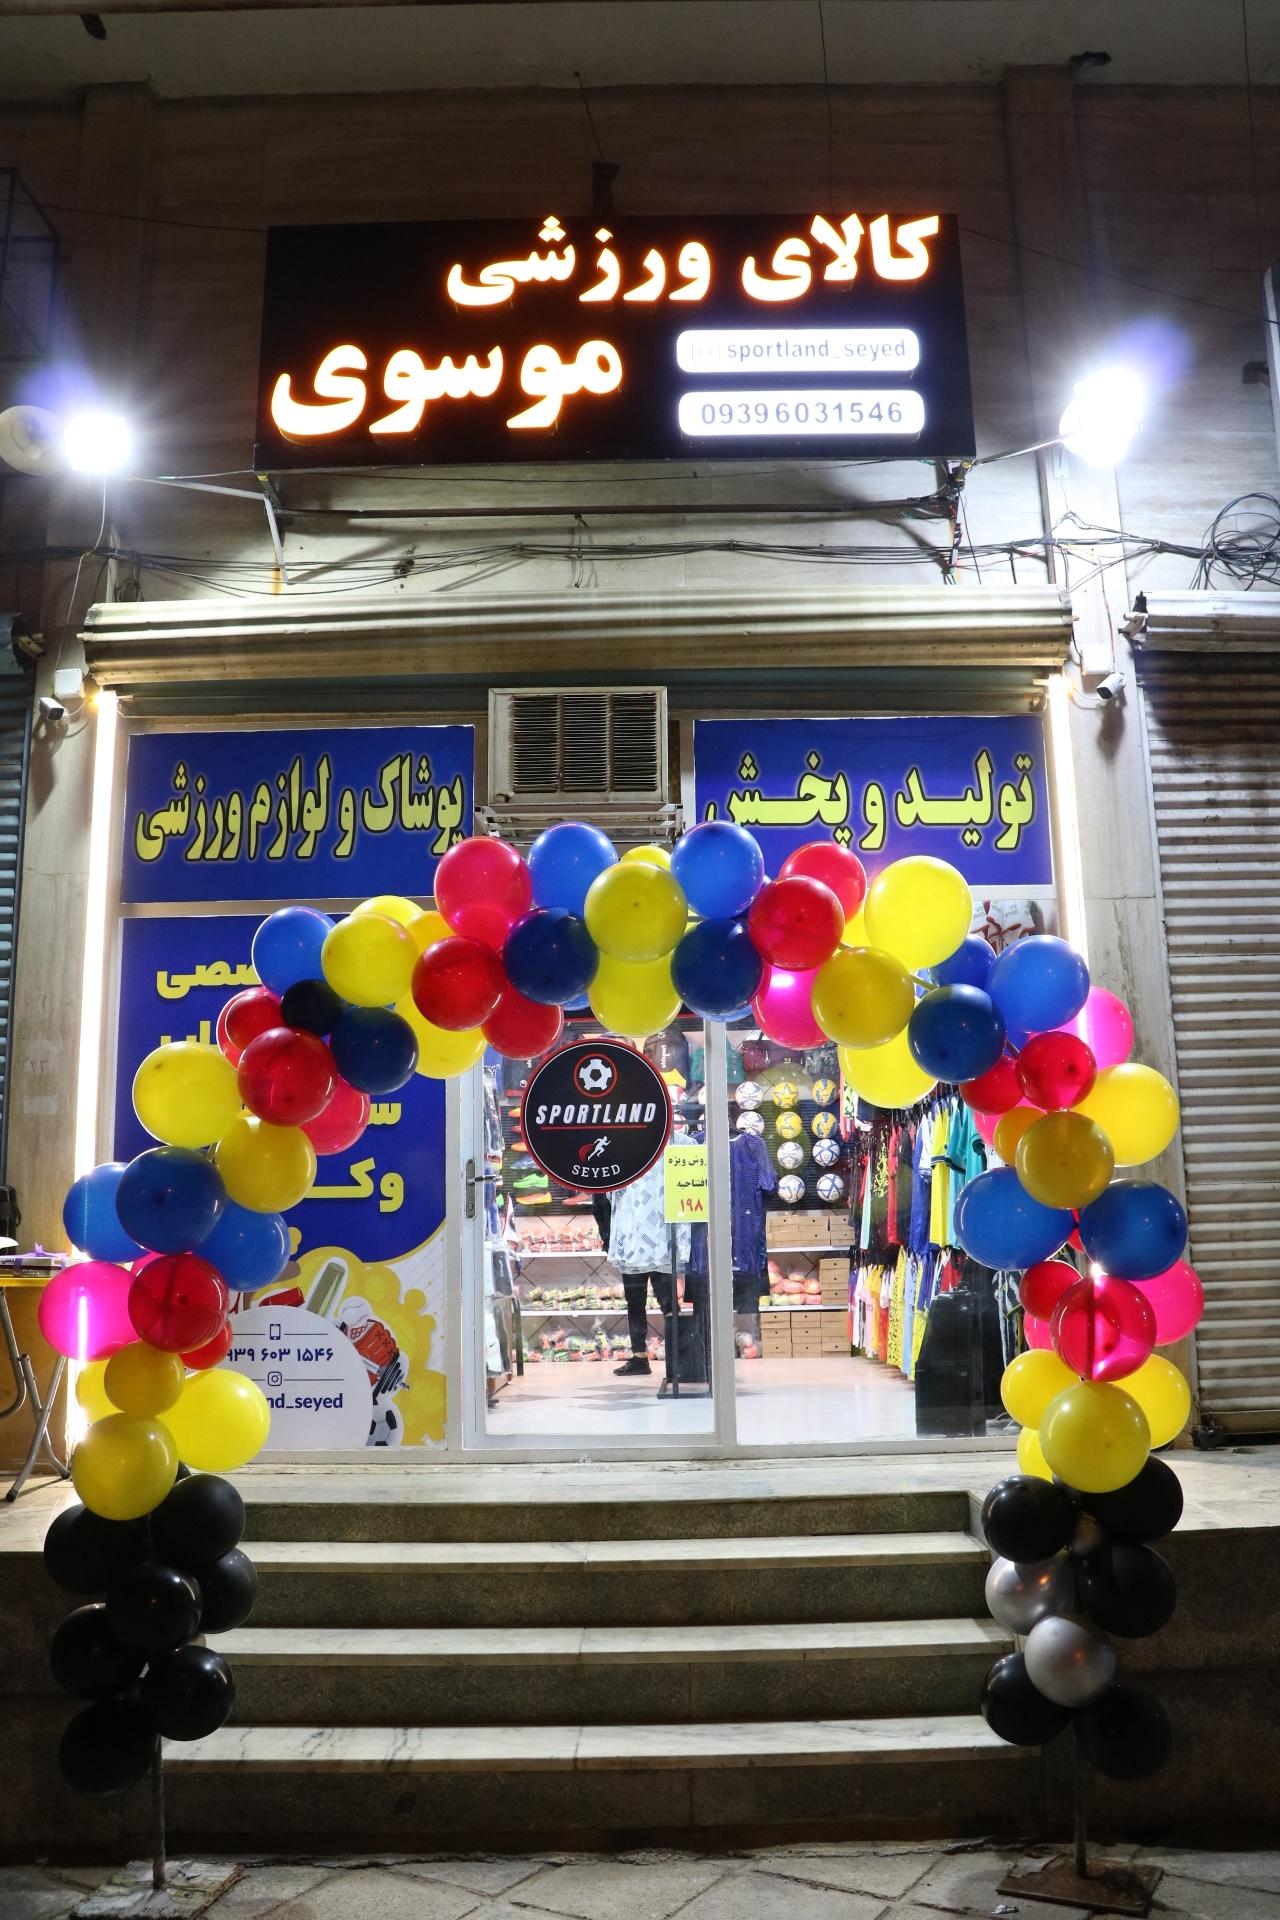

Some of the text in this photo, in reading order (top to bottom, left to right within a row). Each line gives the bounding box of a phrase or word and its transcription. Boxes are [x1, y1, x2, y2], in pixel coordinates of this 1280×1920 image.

[446, 212, 940, 307] کالای ورزشی
[727, 339, 906, 363] sportland_seyed
[269, 338, 624, 438] موسوی
[701, 401, 904, 425] 09396031546
[135, 752, 466, 862] پوشاک و لوازم ورزشی
[895, 748, 1035, 851] تولید
[860, 782, 886, 851] و
[535, 1102, 658, 1126] SPORTLAND
[571, 1163, 621, 1178] SEYED
[680, 1197, 704, 1213] ۱۹۸
[296, 1347, 334, 1362] ۱۵۴۶
